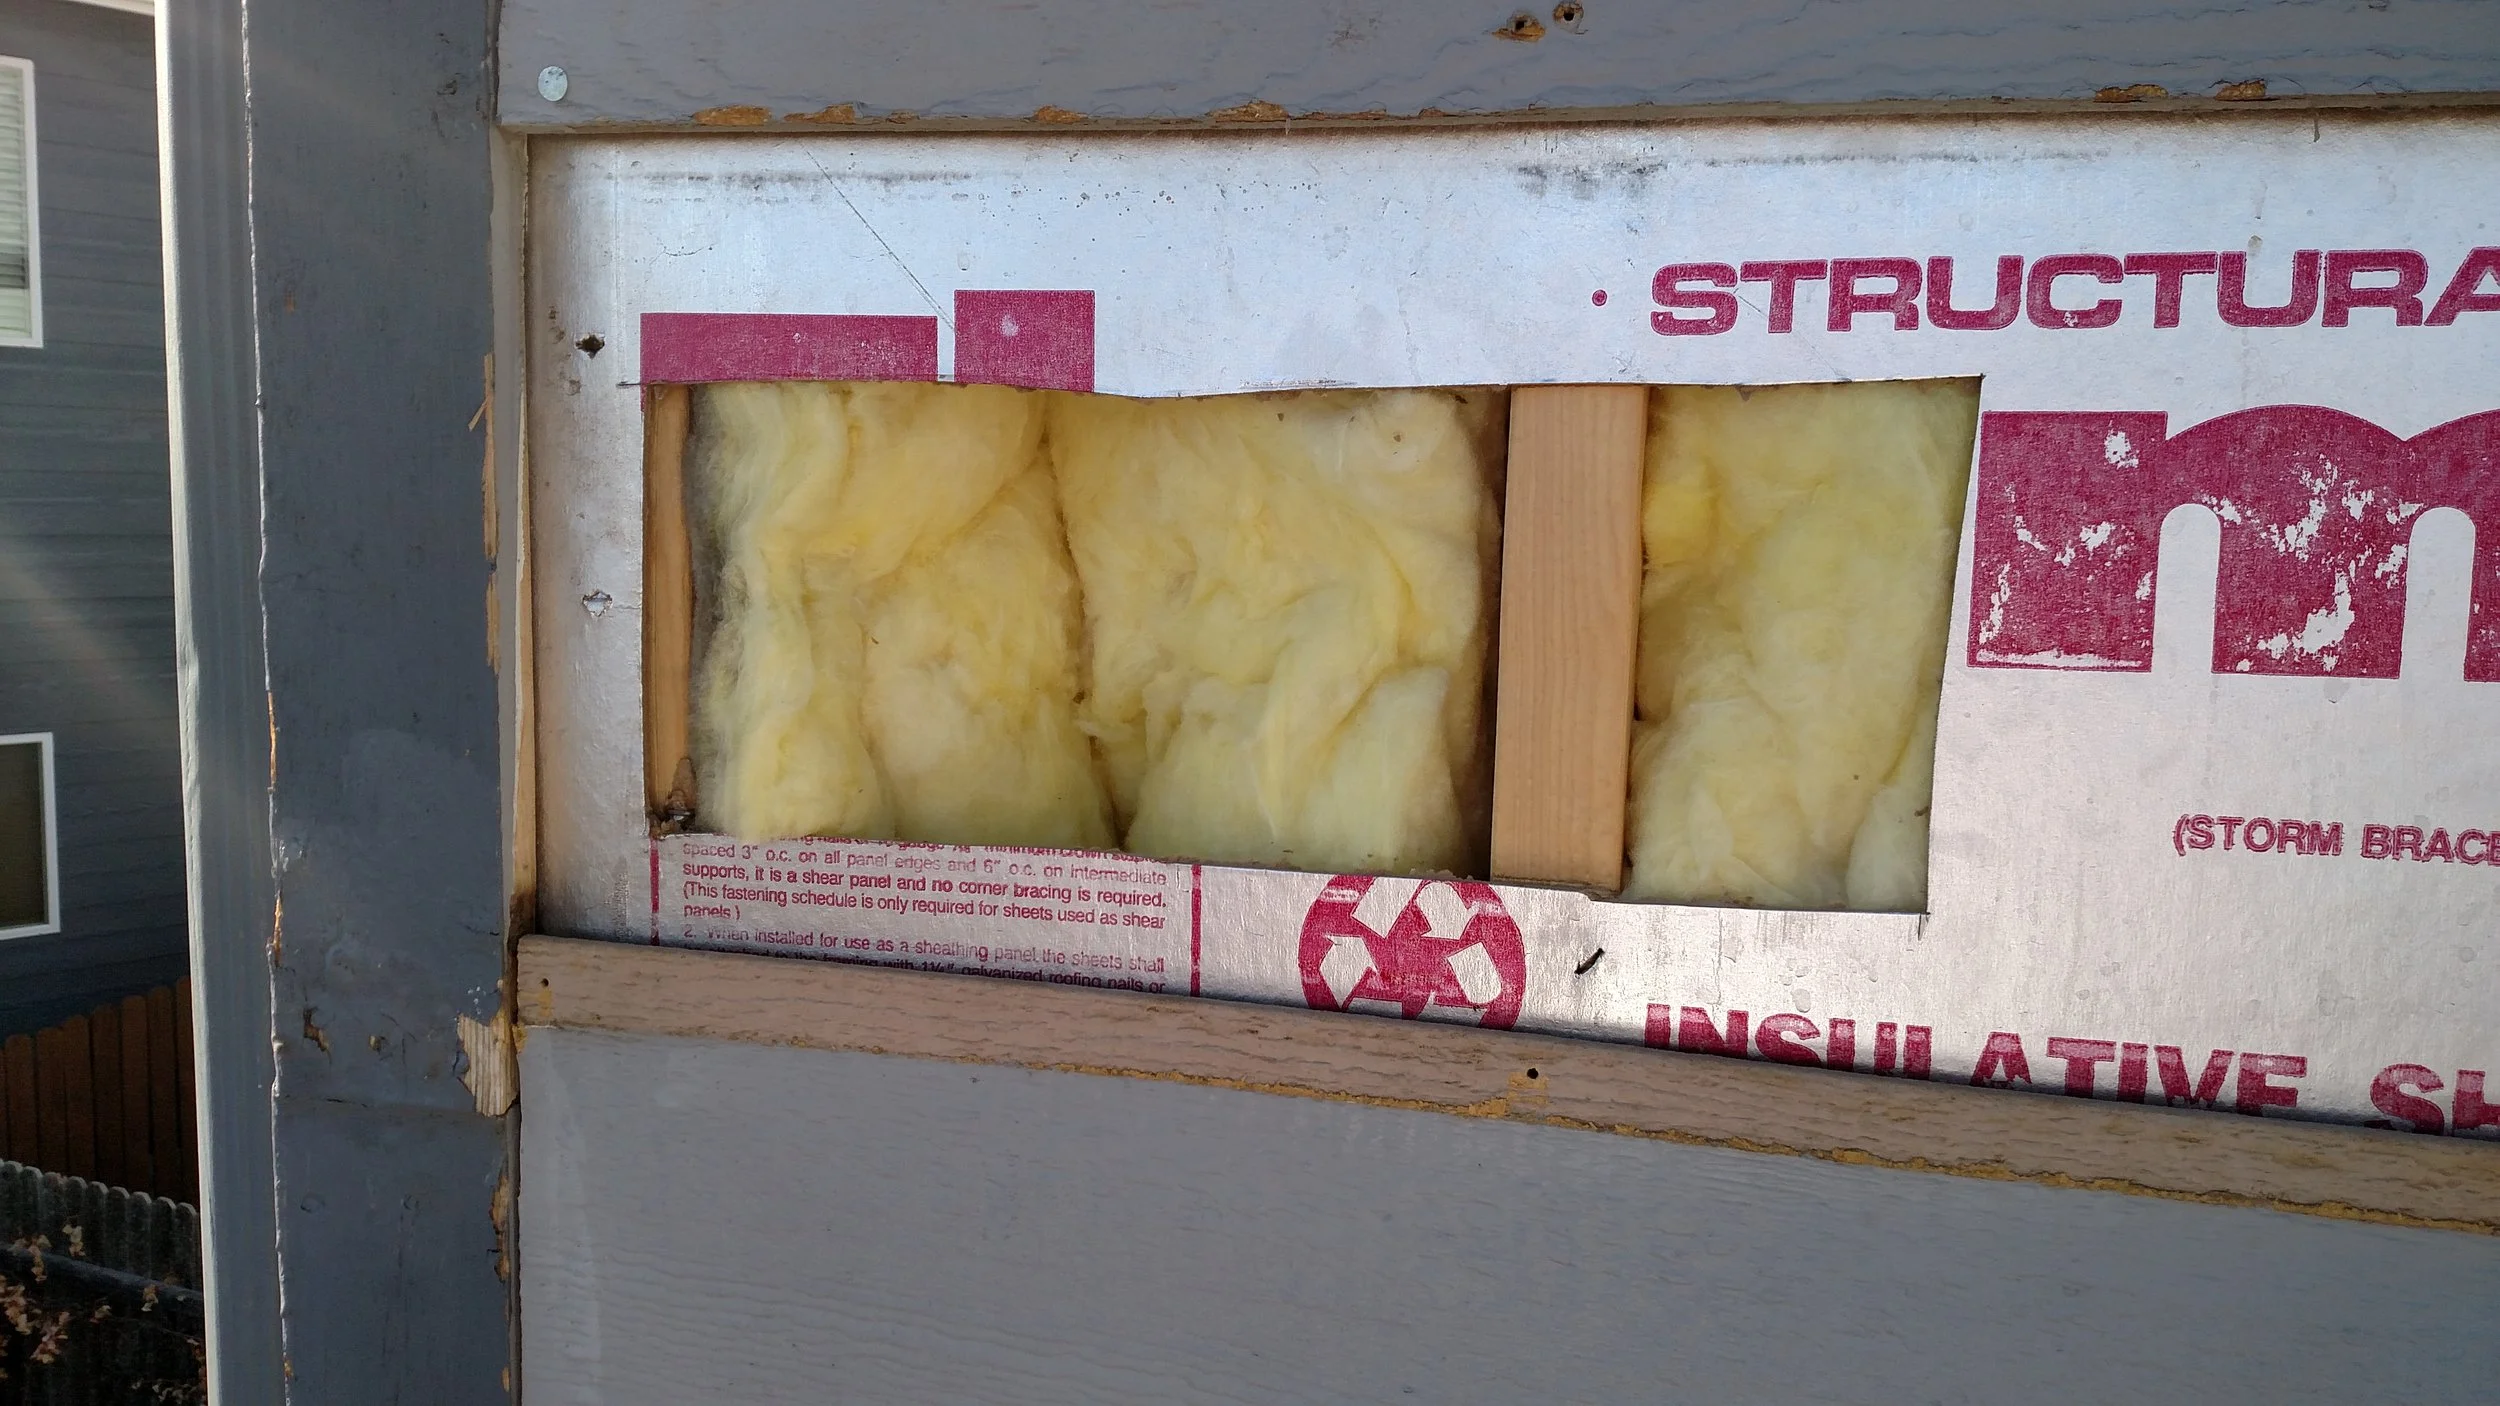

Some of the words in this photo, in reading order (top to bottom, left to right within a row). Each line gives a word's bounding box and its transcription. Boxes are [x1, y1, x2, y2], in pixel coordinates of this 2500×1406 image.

[2173, 814, 2344, 857] (STORM
[683, 843, 735, 858] spaced
[799, 851, 817, 863] on
[824, 850, 841, 864] all
[847, 854, 888, 869] panel
[895, 856, 941, 873] edges
[948, 858, 976, 872] and
[1043, 865, 1063, 877] on
[1071, 864, 1167, 886] intermediate
[683, 863, 749, 881] supports,
[755, 866, 764, 880] it
[769, 867, 782, 882] is
[787, 869, 798, 883] a
[803, 869, 844, 886] shear
[850, 874, 891, 891] panel
[897, 877, 926, 892] and
[932, 878, 953, 893] no
[959, 881, 1008, 897] corner
[1013, 883, 1072, 904] bracing
[1078, 886, 1091, 902] is
[1097, 890, 1166, 907] required.
[683, 881, 718, 900] (This
[722, 884, 787, 907] fastening
[792, 890, 856, 908] schedule
[861, 893, 873, 909] is
[878, 896, 909, 915] only
[912, 900, 974, 918] required
[979, 901, 998, 917] for
[1003, 904, 1053, 921] sheets
[1057, 907, 1095, 924] used
[1100, 912, 1118, 926] as
[1122, 911, 1166, 929] shear
[708, 925, 749, 941] When
[755, 928, 814, 947] installed
[820, 931, 839, 948] for
[844, 937, 870, 950] use
[876, 938, 894, 953] as
[900, 940, 909, 952] a
[914, 939, 988, 962] sheathing
[1043, 948, 1066, 965] the
[1072, 951, 1122, 970] sheets
[1129, 954, 1165, 973] shall
[1107, 976, 1144, 993] nails
[1148, 981, 1166, 994] or
